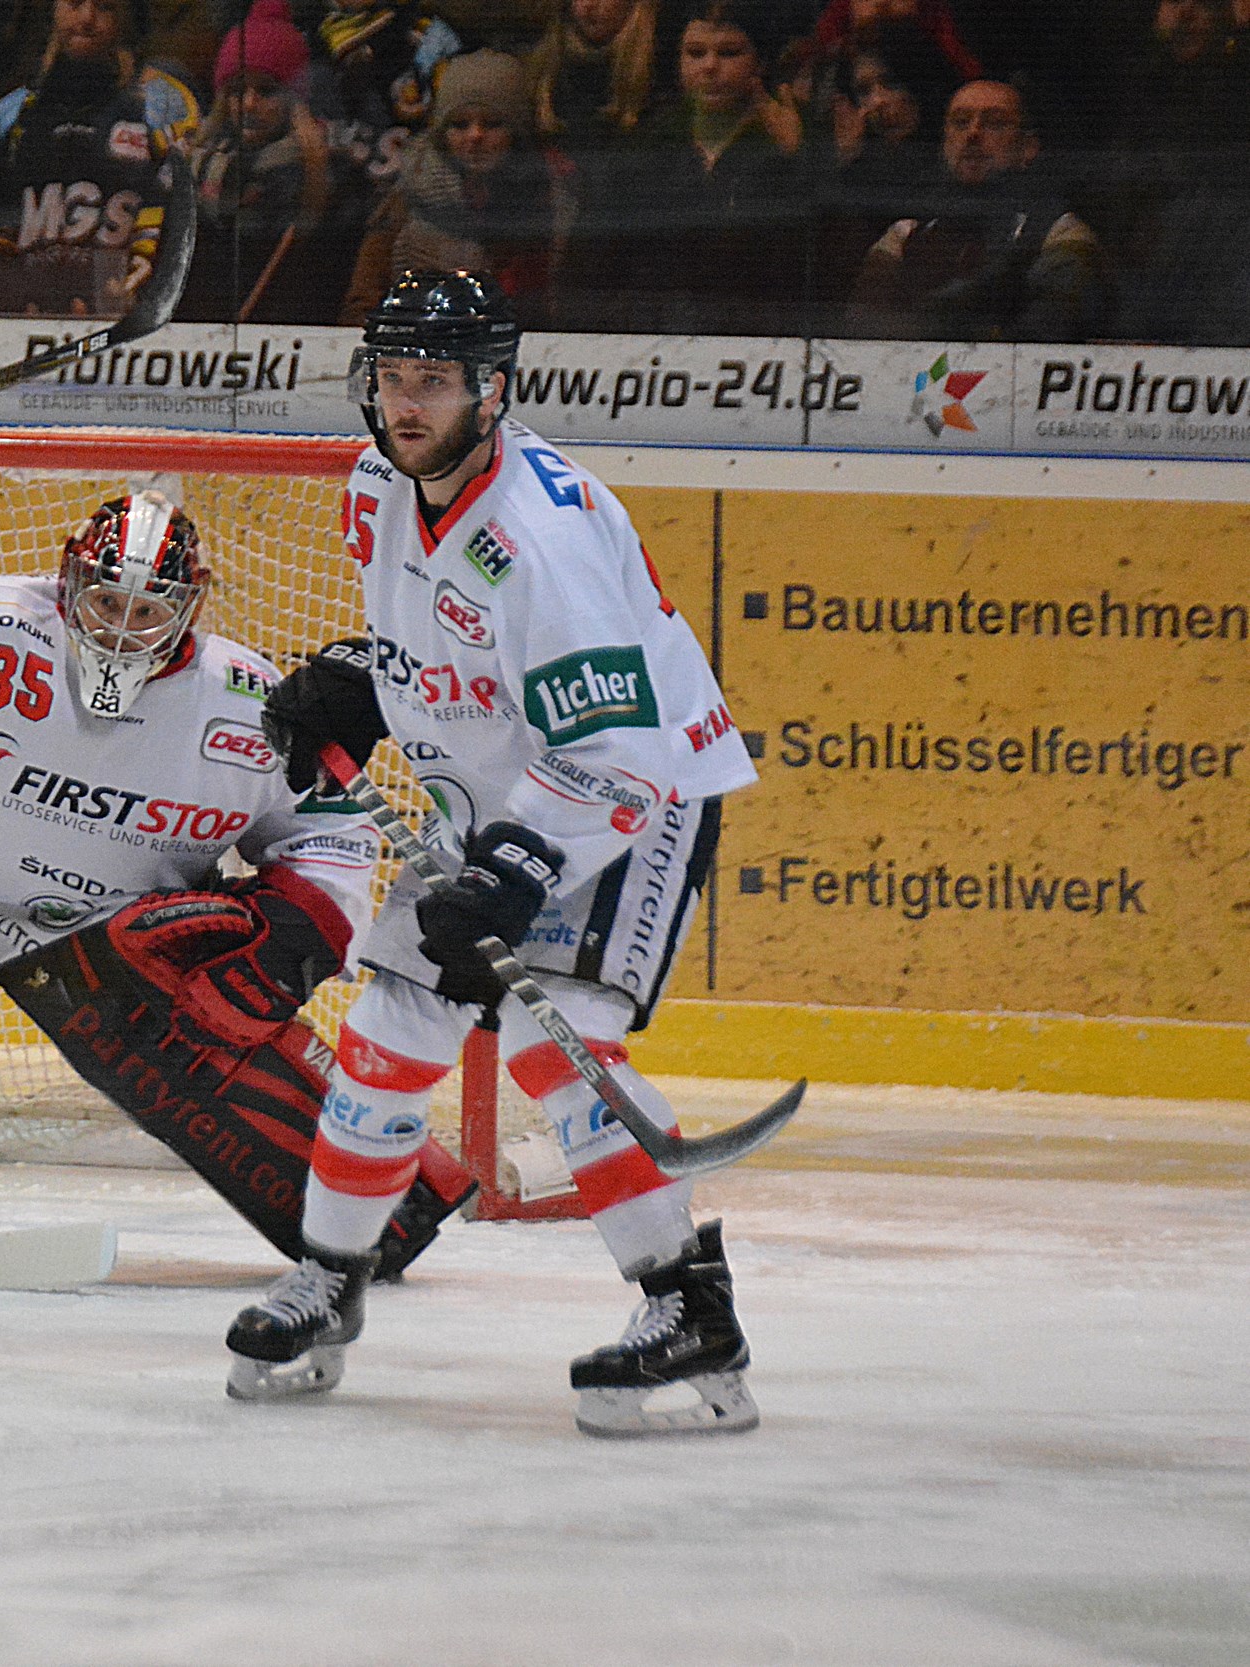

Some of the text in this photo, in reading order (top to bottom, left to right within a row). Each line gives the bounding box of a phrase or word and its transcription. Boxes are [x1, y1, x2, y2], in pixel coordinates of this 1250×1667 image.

[515, 356, 863, 419] ww.pio-24.de
[1037, 360, 1250, 415] Piotrow
[1168, 424, 1250, 443] INDUSTRI
[356, 458, 394, 482] KUHL
[467, 526, 514, 577] FFH
[16, 617, 56, 649] KUHL
[782, 582, 1250, 640] Bauunternehmen
[536, 660, 638, 732] Licher
[779, 719, 1244, 791] Schlüsselfertiger
[10, 764, 250, 841] FIRSTSTOP
[109, 830, 145, 846] UND
[622, 800, 689, 990] artyrent.c
[777, 856, 1147, 921] Fertigteilwerk
[60, 1003, 305, 1217] partyrent.co
